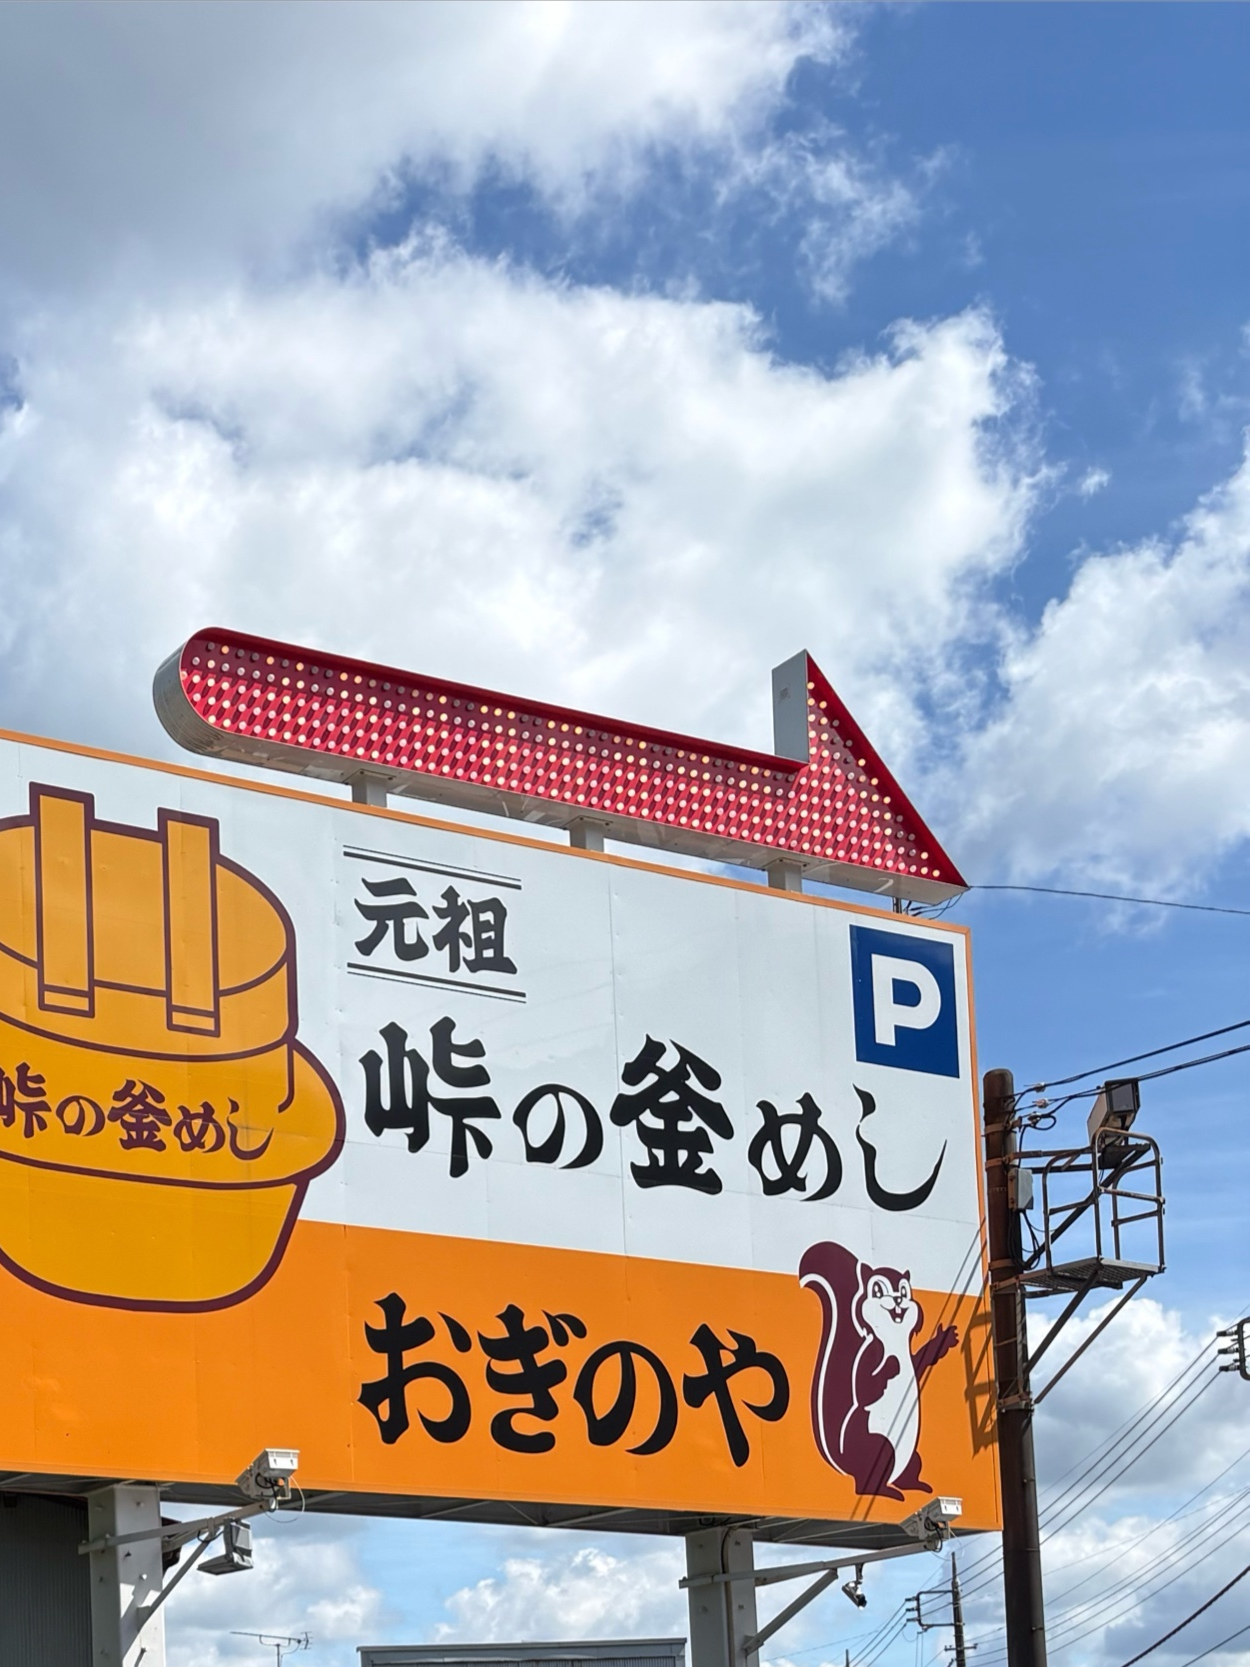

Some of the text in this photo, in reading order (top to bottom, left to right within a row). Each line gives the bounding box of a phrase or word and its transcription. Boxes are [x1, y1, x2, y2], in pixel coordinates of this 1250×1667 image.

[355, 877, 518, 975] 元祖
[871, 953, 941, 1046] P
[359, 1016, 948, 1212] 峠の釜めし
[357, 1292, 790, 1468] おぎのや
